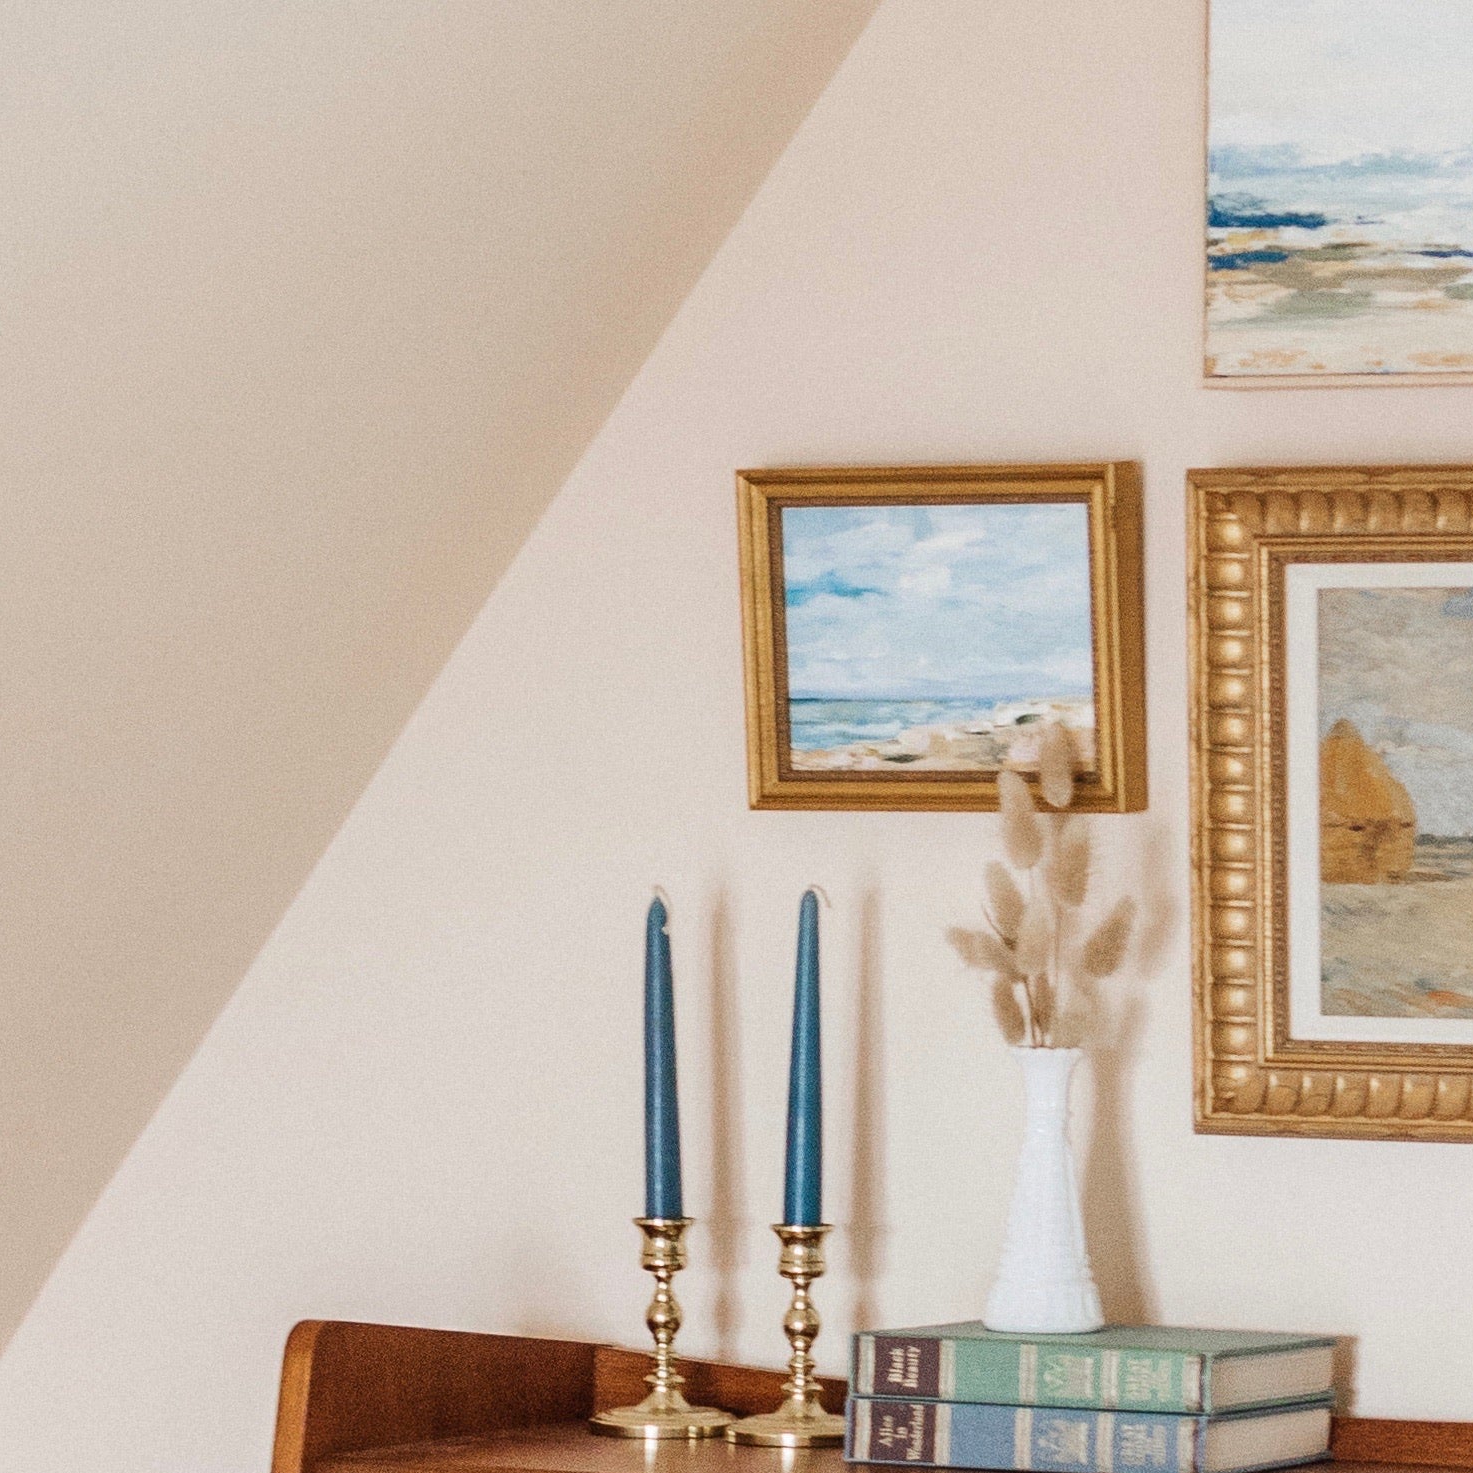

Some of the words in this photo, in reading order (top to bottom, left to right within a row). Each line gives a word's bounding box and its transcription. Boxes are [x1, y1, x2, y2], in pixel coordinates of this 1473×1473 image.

[887, 1347, 905, 1383] Black
[903, 1345, 921, 1388] Beauty
[878, 1415, 894, 1447] Alice
[893, 1426, 908, 1439] in
[906, 1403, 924, 1461] Wonderland
